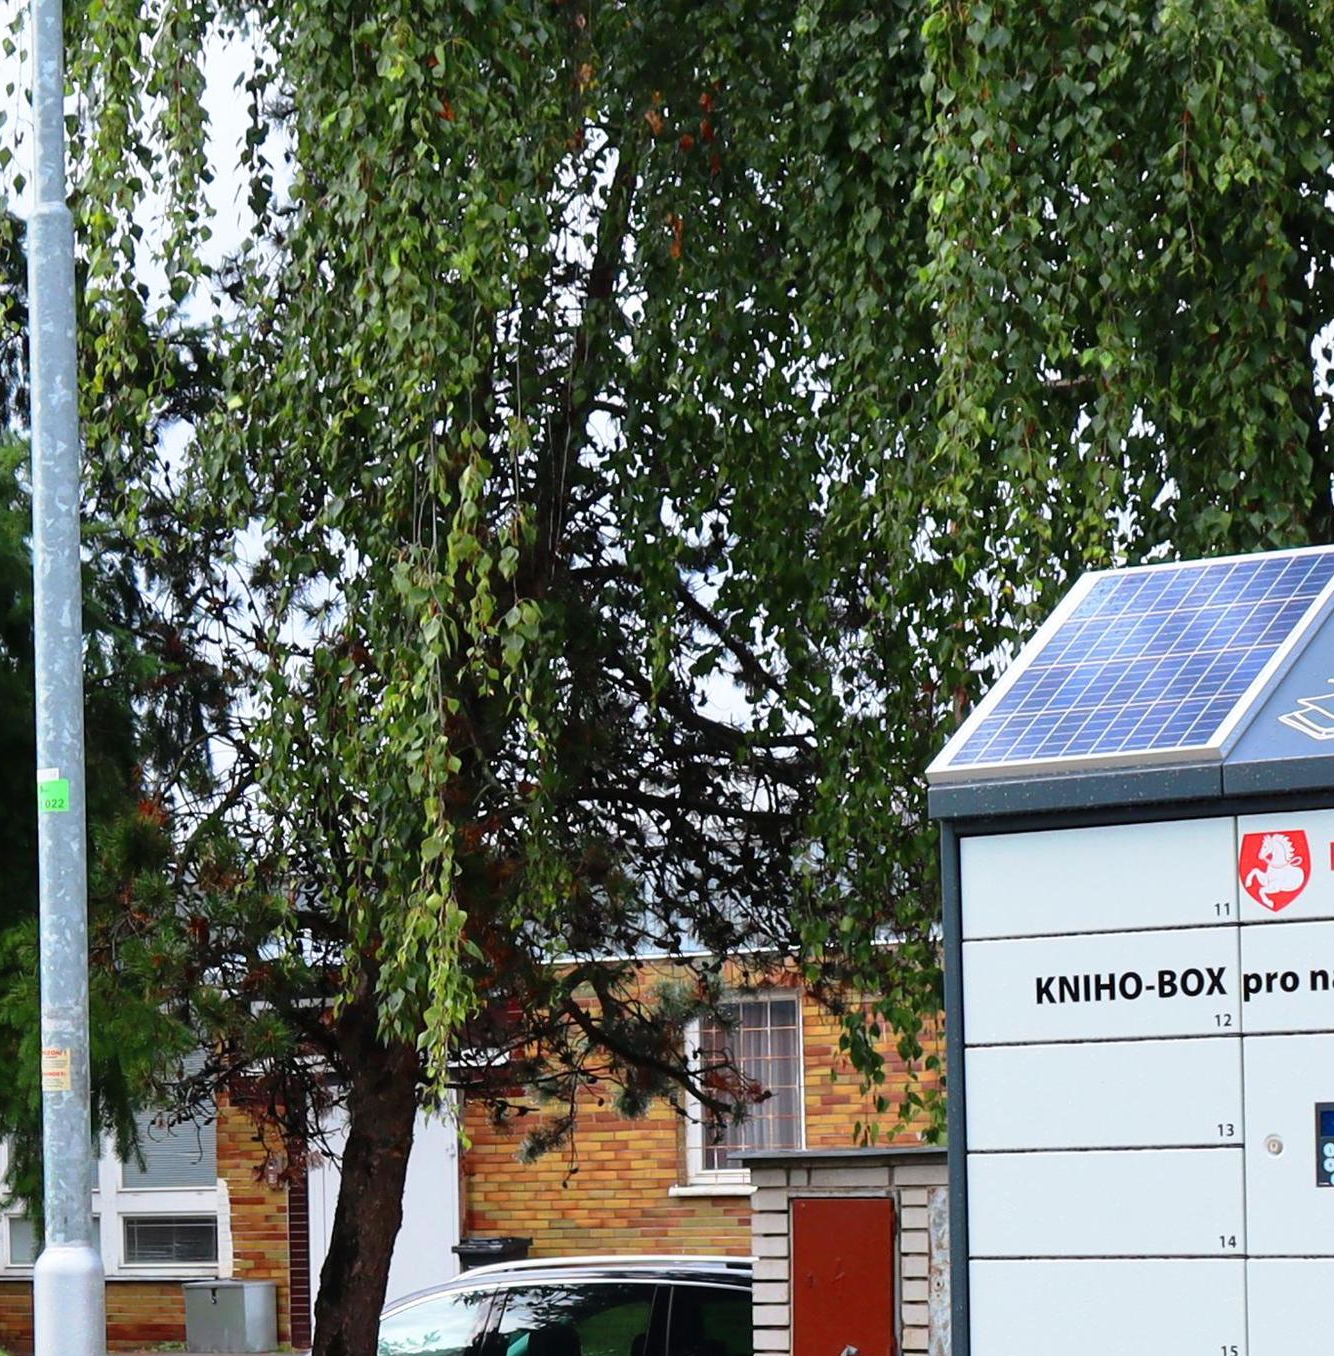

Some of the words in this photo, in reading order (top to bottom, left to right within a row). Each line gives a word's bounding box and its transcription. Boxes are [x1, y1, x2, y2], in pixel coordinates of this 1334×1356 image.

[1214, 903, 1230, 916] 11
[1036, 966, 1227, 1005] KNIHO-BOX
[1243, 971, 1299, 1003] pro
[1214, 1014, 1231, 1026] 12
[1217, 1124, 1234, 1136] 13
[1219, 1236, 1236, 1248] 14
